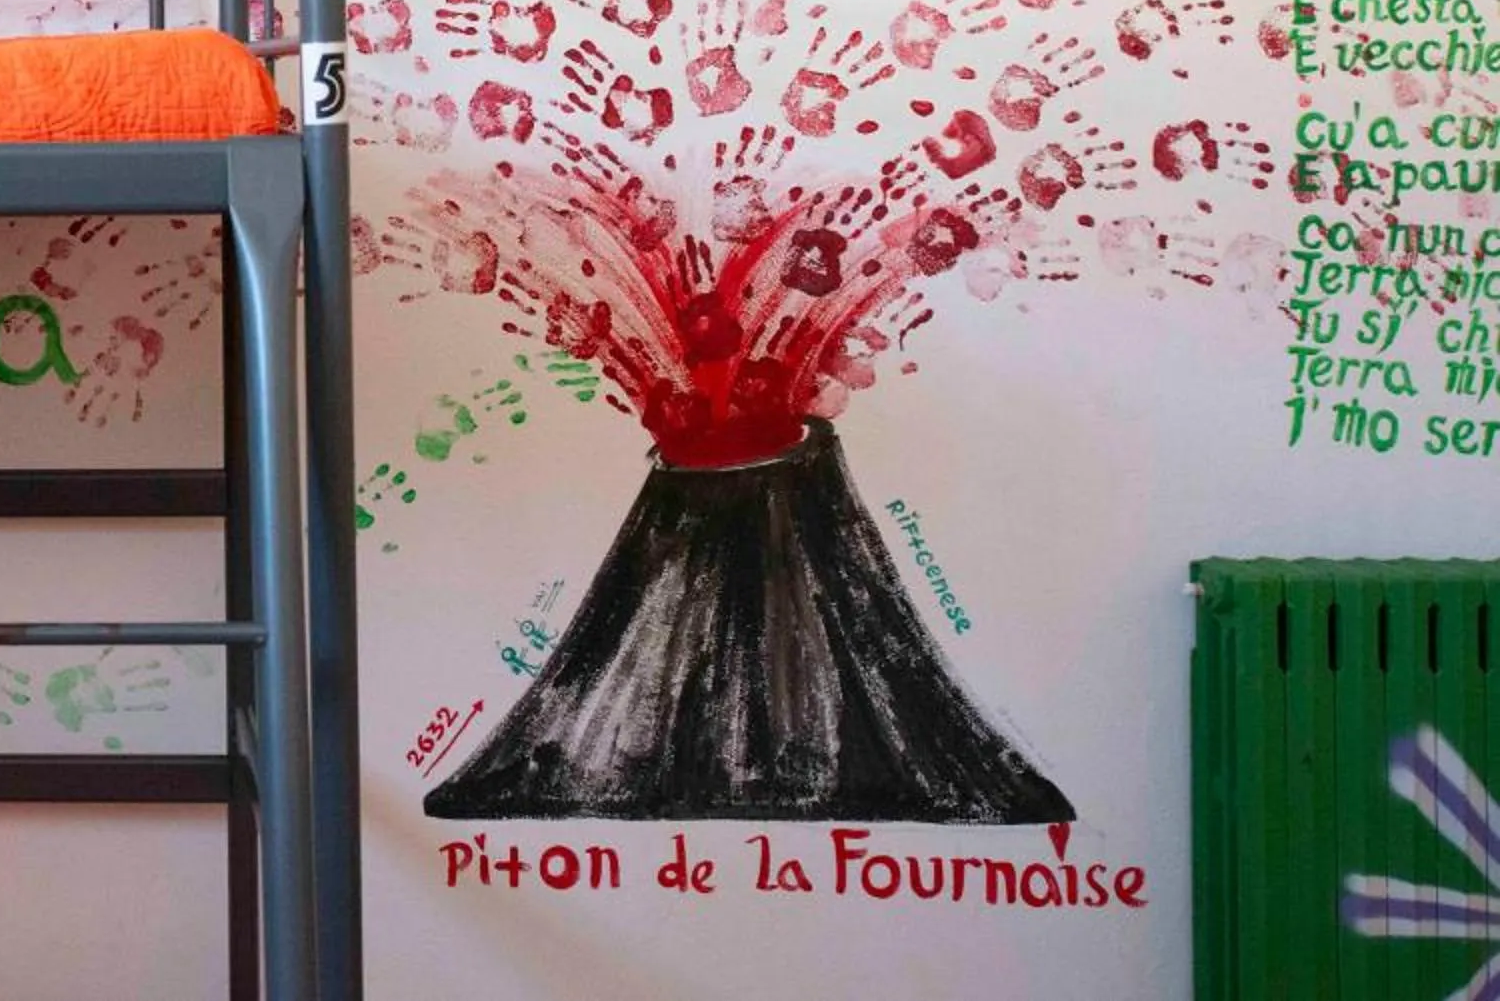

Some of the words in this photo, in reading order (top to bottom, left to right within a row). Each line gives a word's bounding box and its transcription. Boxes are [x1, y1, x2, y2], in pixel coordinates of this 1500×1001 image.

[313, 52, 346, 119] 5
[1290, 251, 1428, 298] Terra
[1288, 299, 1340, 345] Tu
[1286, 346, 1418, 397] Terra
[406, 706, 460, 769] 2632
[654, 831, 717, 894] de
[828, 821, 1152, 911] Fournaise
